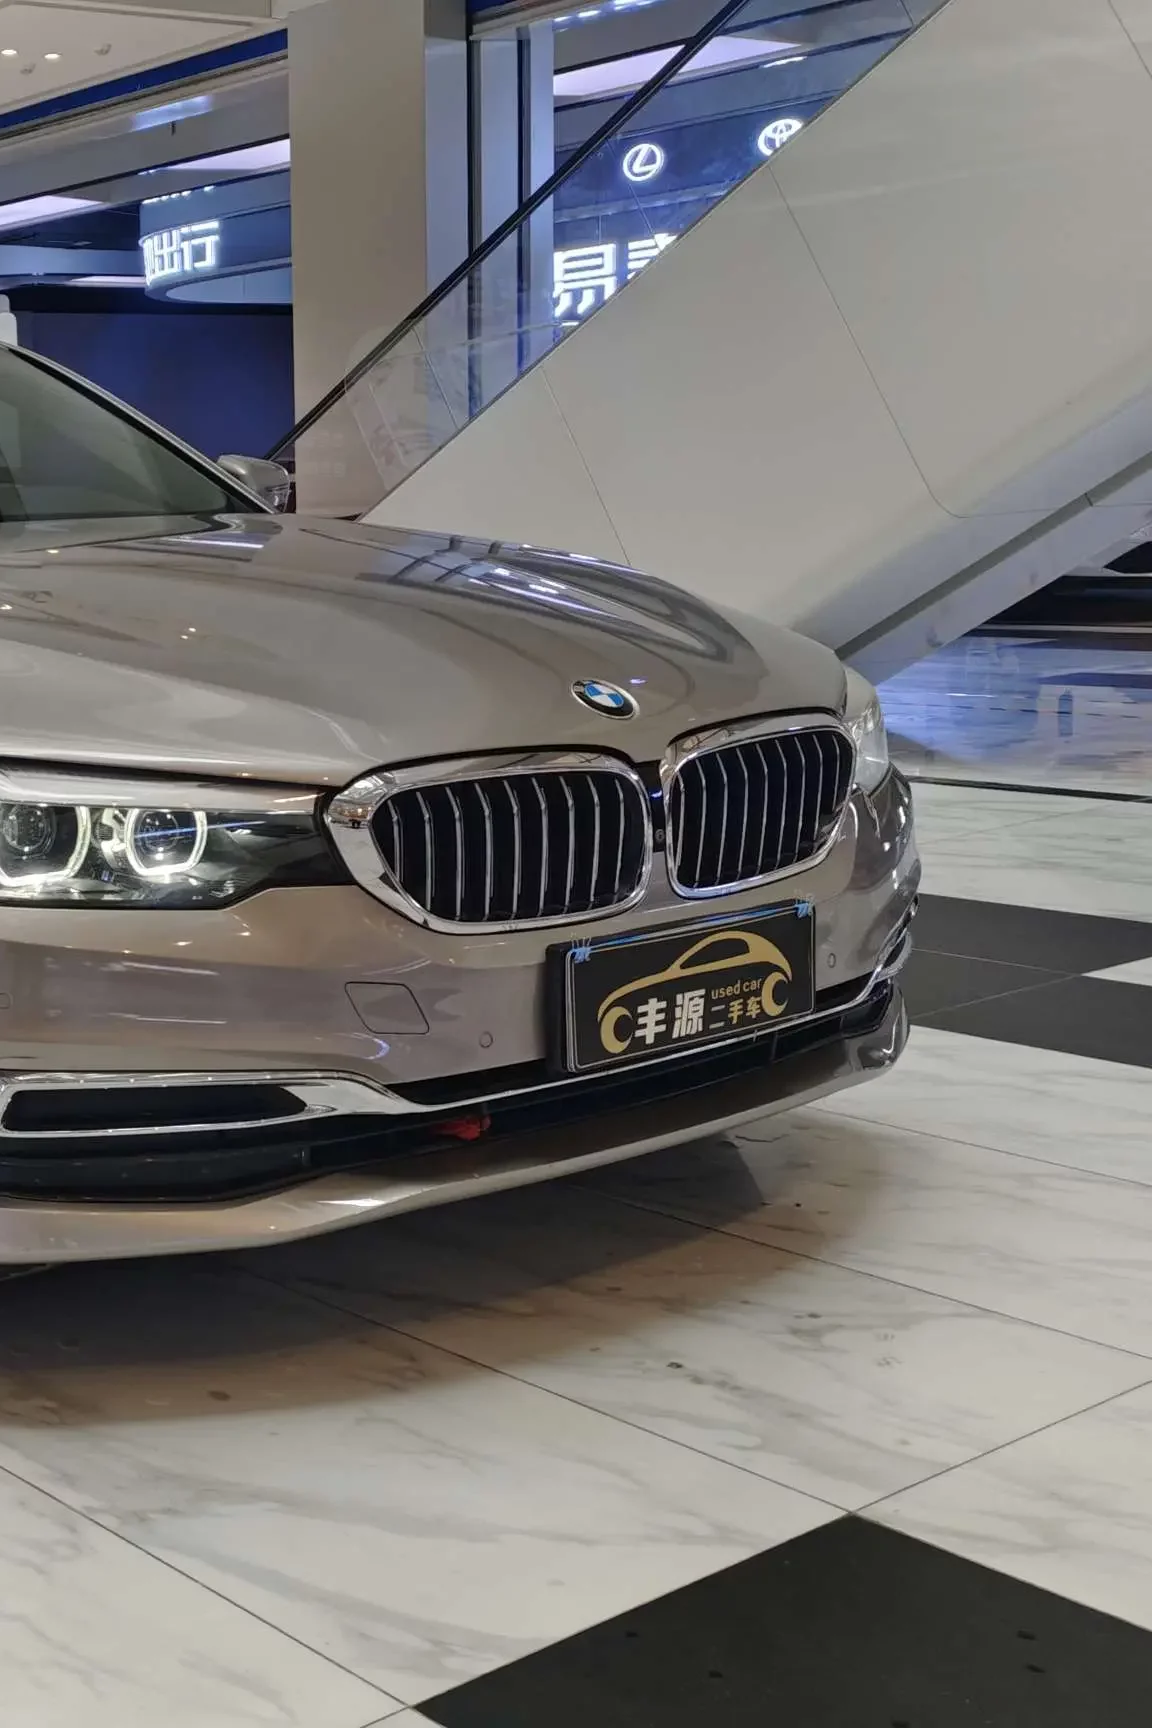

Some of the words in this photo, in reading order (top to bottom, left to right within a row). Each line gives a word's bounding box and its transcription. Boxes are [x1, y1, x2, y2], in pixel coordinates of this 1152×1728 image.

[711, 980, 741, 1000] used
[743, 978, 763, 993] car
[634, 989, 706, 1045] 丰源
[709, 996, 762, 1030] 二手车
